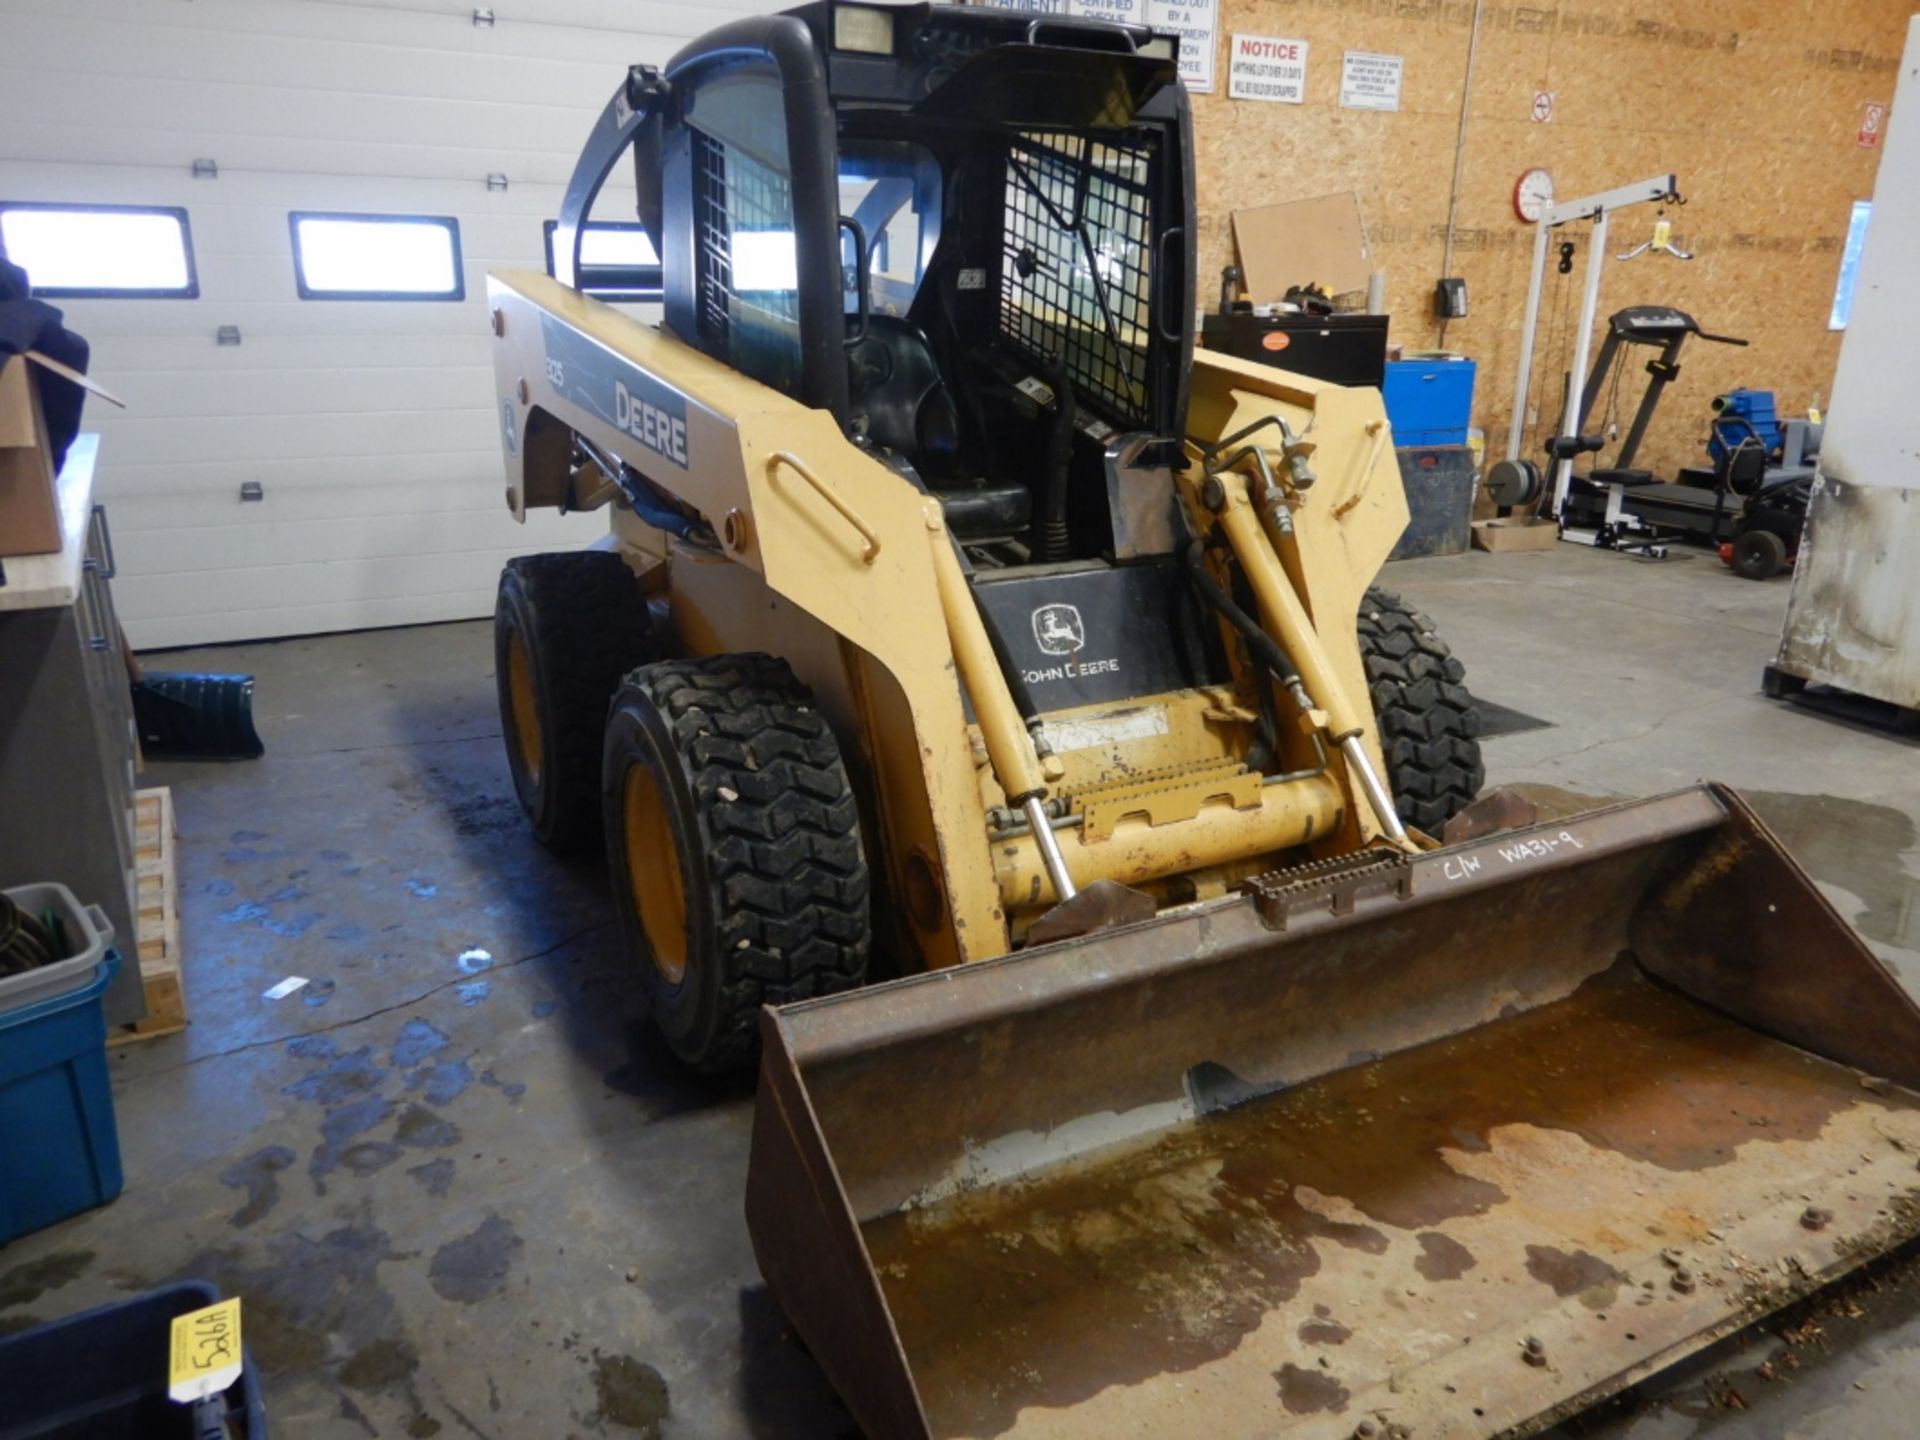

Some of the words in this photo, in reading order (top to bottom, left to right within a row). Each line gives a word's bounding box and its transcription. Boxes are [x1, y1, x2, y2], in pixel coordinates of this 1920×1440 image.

[990, 0, 1058, 13] AYMENT
[1167, 10, 1180, 21] BY
[1183, 11, 1191, 22] A
[1240, 39, 1299, 60] NOTICE
[615, 380, 687, 466] DEERE
[1064, 659, 1120, 679] DEERE
